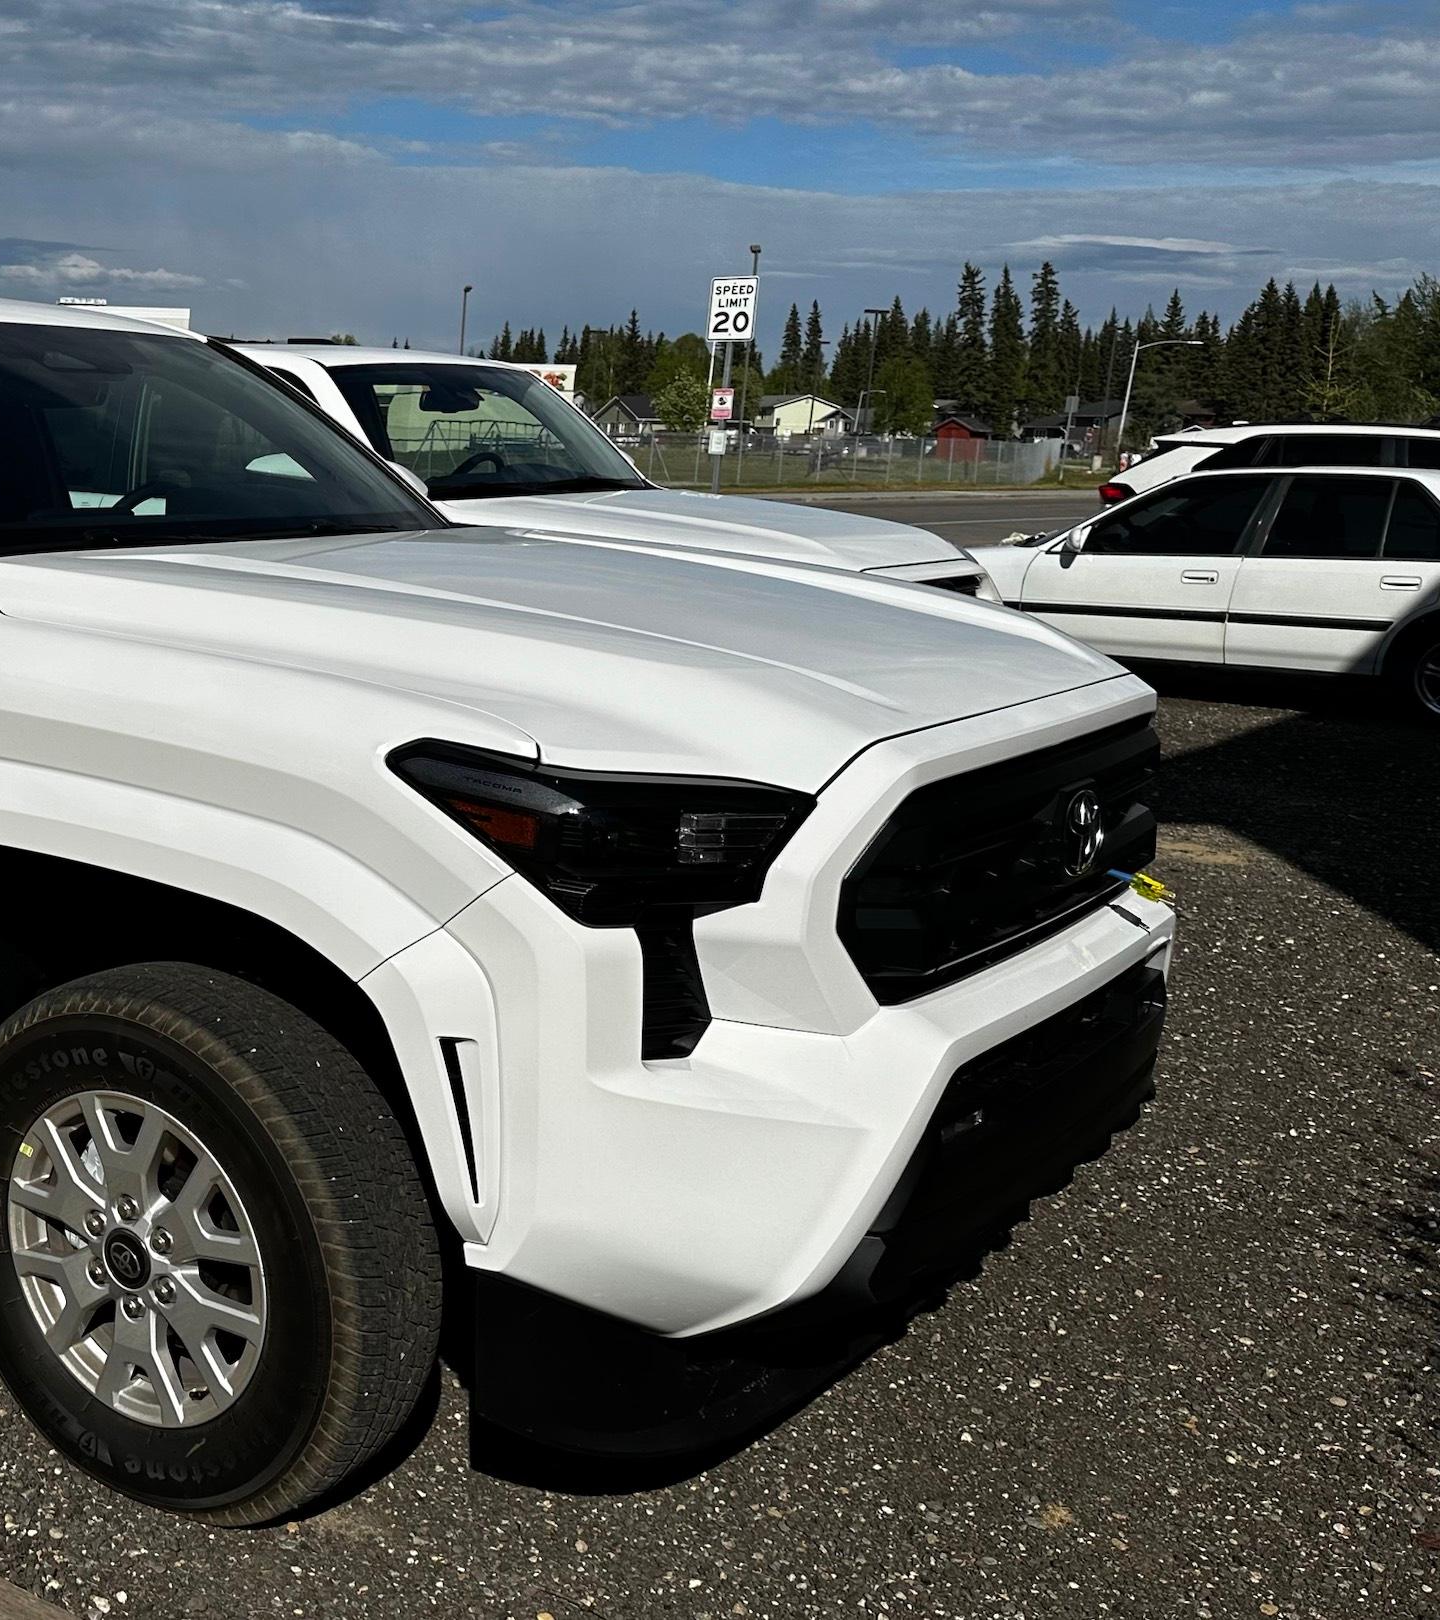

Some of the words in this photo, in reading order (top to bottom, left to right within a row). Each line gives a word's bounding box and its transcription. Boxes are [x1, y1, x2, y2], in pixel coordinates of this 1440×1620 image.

[715, 285, 754, 295] SPEED
[718, 297, 749, 308] LIMIT
[712, 311, 749, 333] 20
[464, 776, 523, 794] TACOMA
